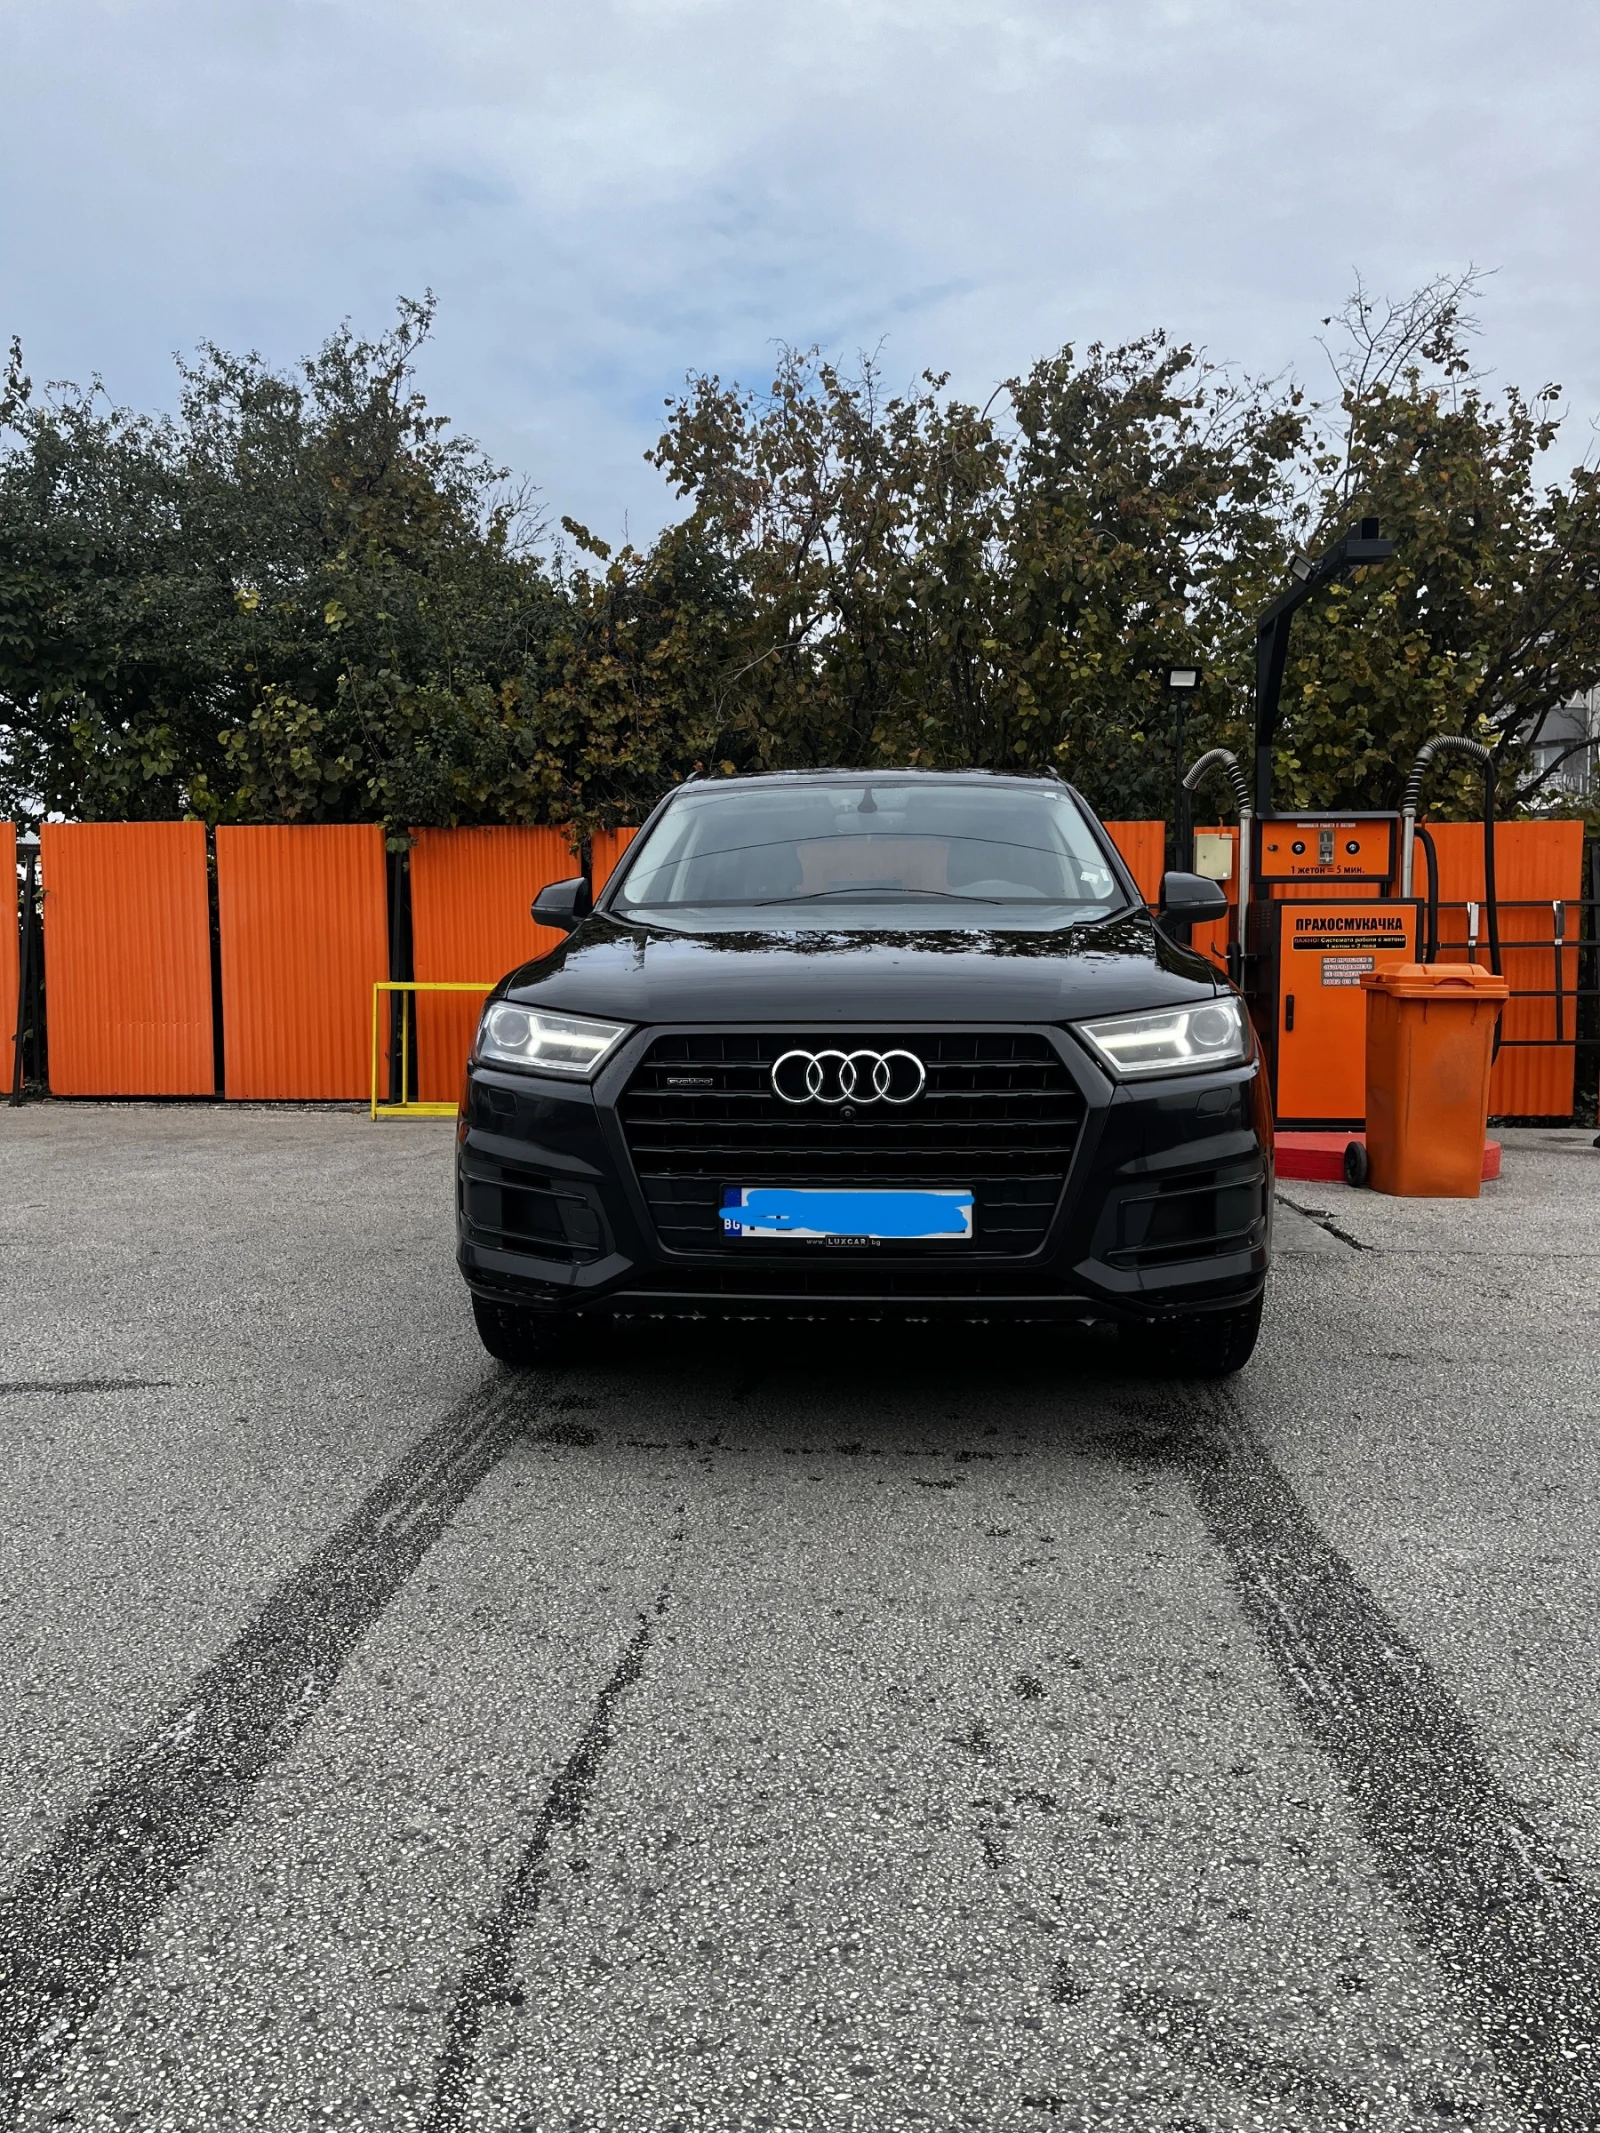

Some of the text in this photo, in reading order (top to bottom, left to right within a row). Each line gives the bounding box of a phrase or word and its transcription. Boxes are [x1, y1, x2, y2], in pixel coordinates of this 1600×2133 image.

[1336, 866, 1341, 874] 5
[1296, 918, 1402, 930] ПРАХОСМУКАЧКА
[724, 1218, 740, 1230] BG
